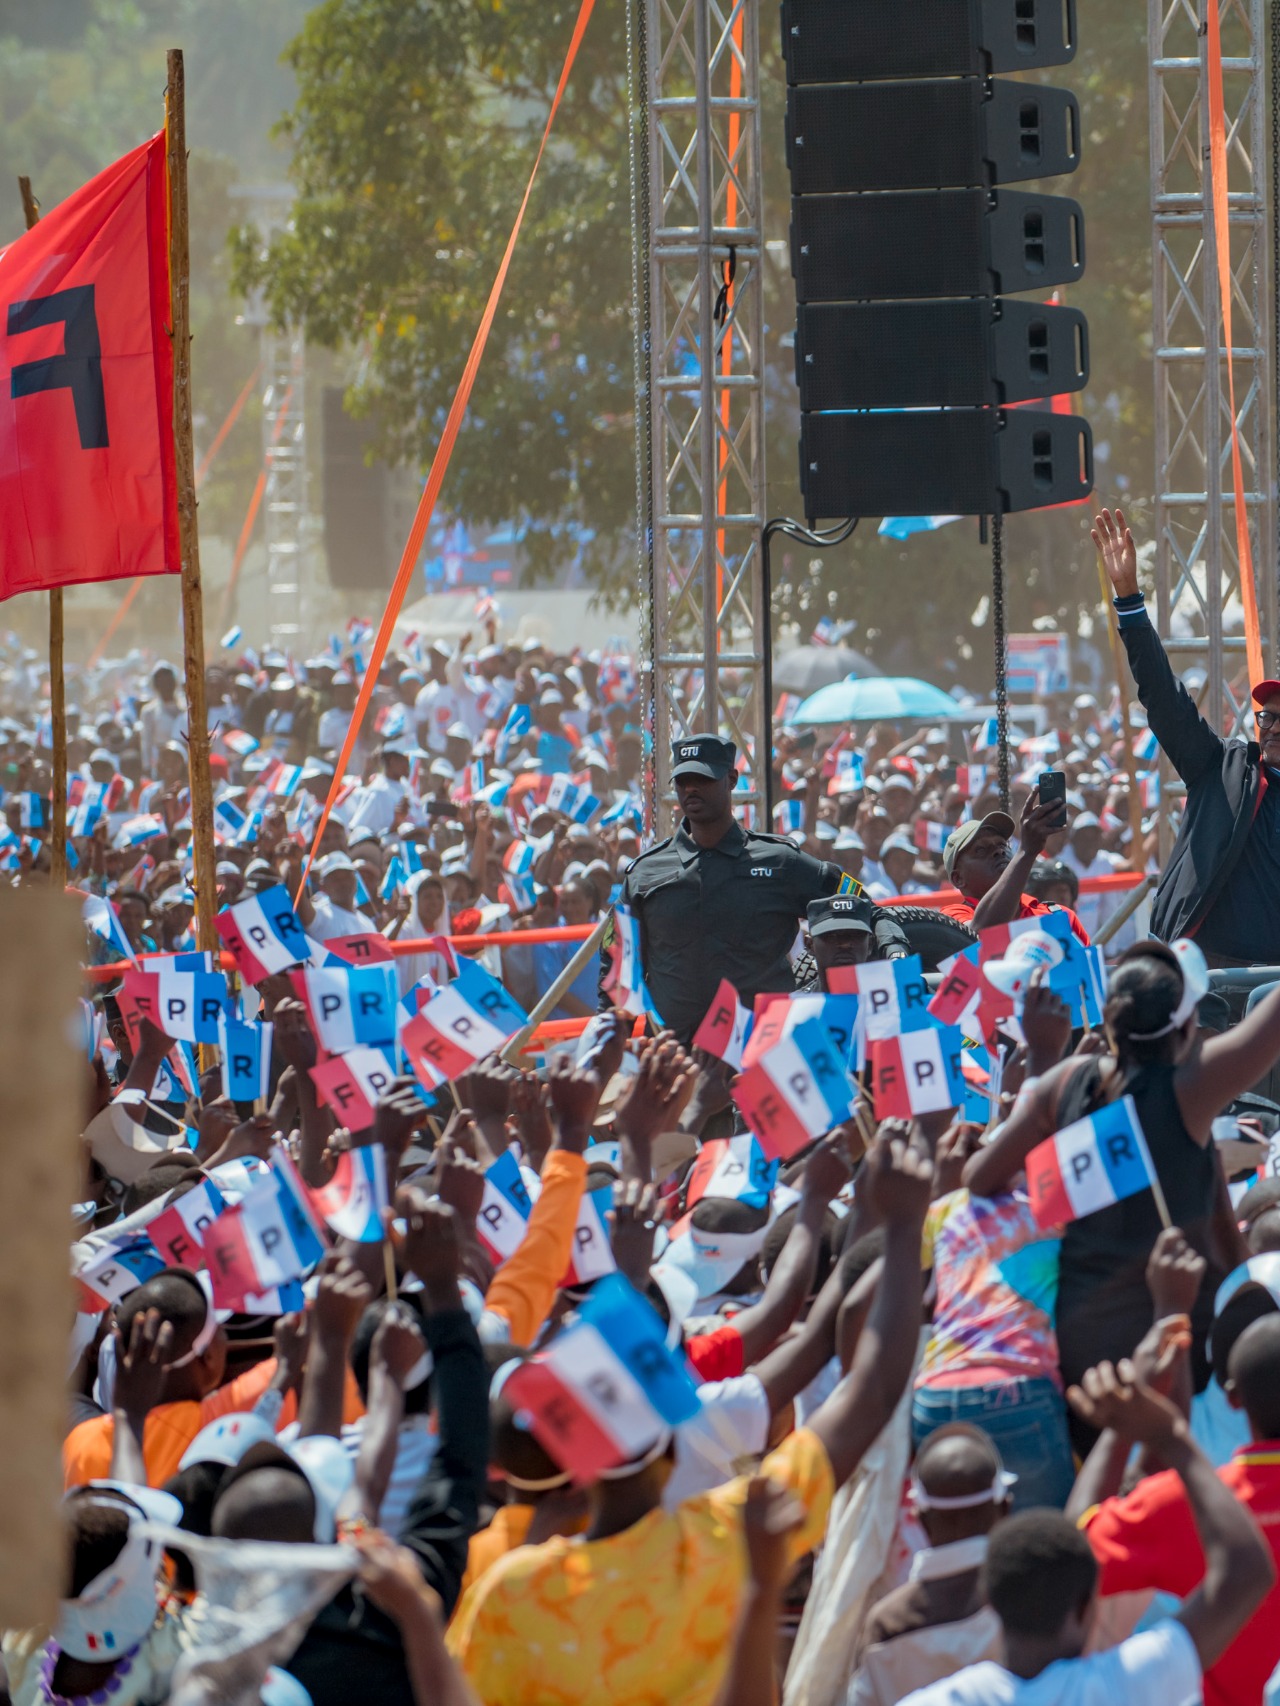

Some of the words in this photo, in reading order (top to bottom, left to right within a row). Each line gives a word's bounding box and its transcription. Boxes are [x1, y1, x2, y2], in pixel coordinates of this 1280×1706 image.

[680, 746, 700, 757] CTU
[750, 867, 773, 877] CTU
[832, 900, 853, 911] CTU
